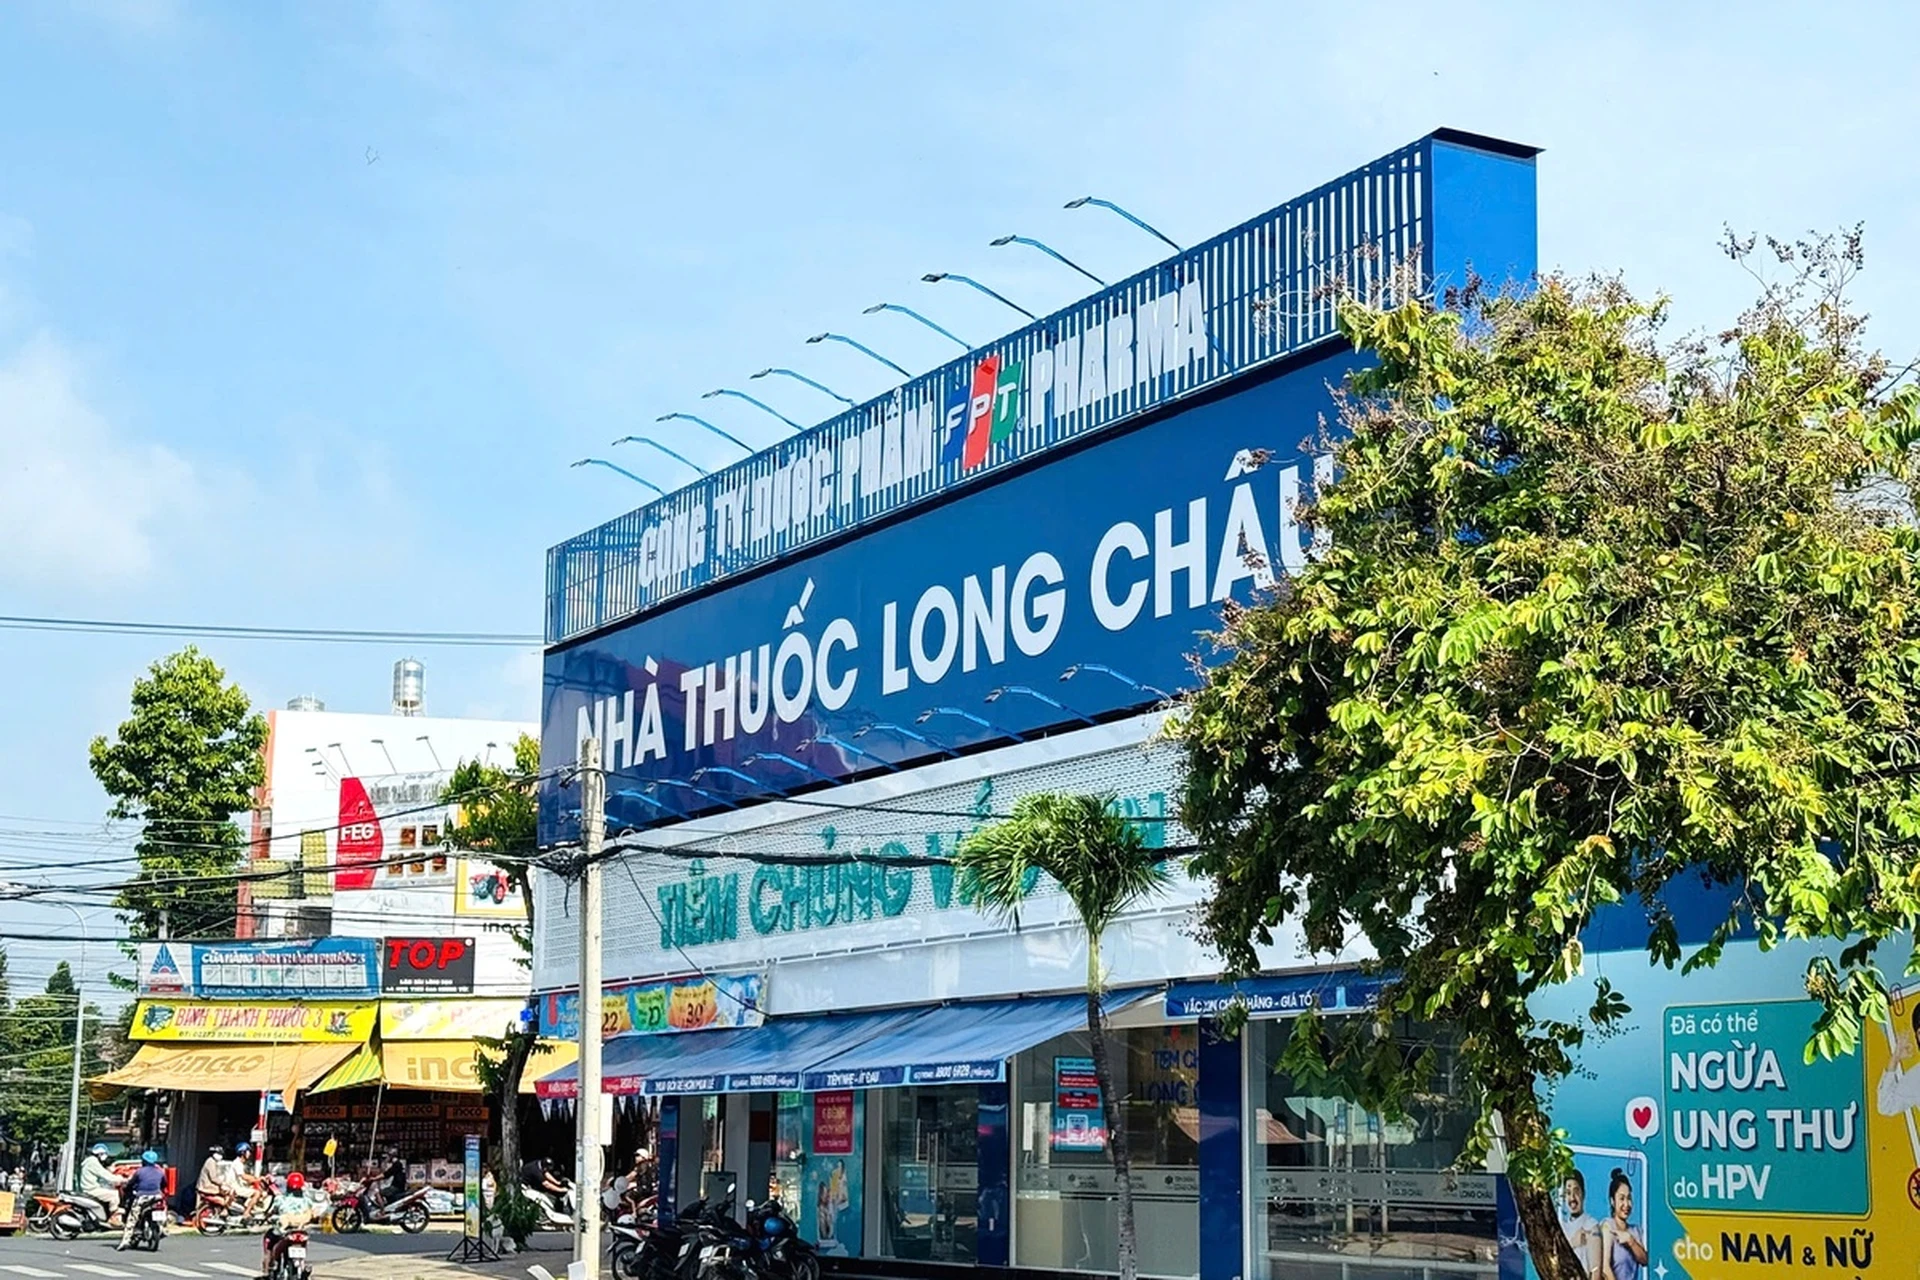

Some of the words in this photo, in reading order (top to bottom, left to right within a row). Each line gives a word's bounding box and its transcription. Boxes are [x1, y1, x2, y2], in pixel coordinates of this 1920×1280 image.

[639, 503, 706, 588] CÔNG
[713, 483, 748, 559] TY
[752, 445, 834, 544] DƯỢC
[840, 387, 934, 515] PHẨM
[1030, 279, 1207, 428] PHARMA
[576, 655, 667, 782] NHÀ
[680, 577, 859, 752] THUỐC
[882, 551, 1066, 695] LONG
[1090, 448, 1334, 632] CHÂU
[341, 822, 375, 841] FEG
[658, 857, 739, 949] TIÊM
[749, 824, 913, 935] CHỦNG
[387, 938, 465, 970] TOP
[1281, 992, 1298, 1008] GIÁ
[1299, 989, 1320, 1006] TỐ
[313, 1008, 324, 1028] 3
[1670, 1014, 1697, 1035] Đã
[1701, 1012, 1722, 1034] có
[1727, 1009, 1758, 1033] thể
[1671, 1039, 1786, 1091] NGỪA
[1673, 1109, 1757, 1151] UNG
[1766, 1101, 1858, 1151] THƯ
[1674, 1176, 1698, 1198] do
[1701, 1164, 1772, 1200] HPV
[1673, 1235, 1713, 1262] cho
[1721, 1232, 1793, 1265] NAM
[1802, 1247, 1817, 1266] &
[1825, 1229, 1875, 1269] NỮ
